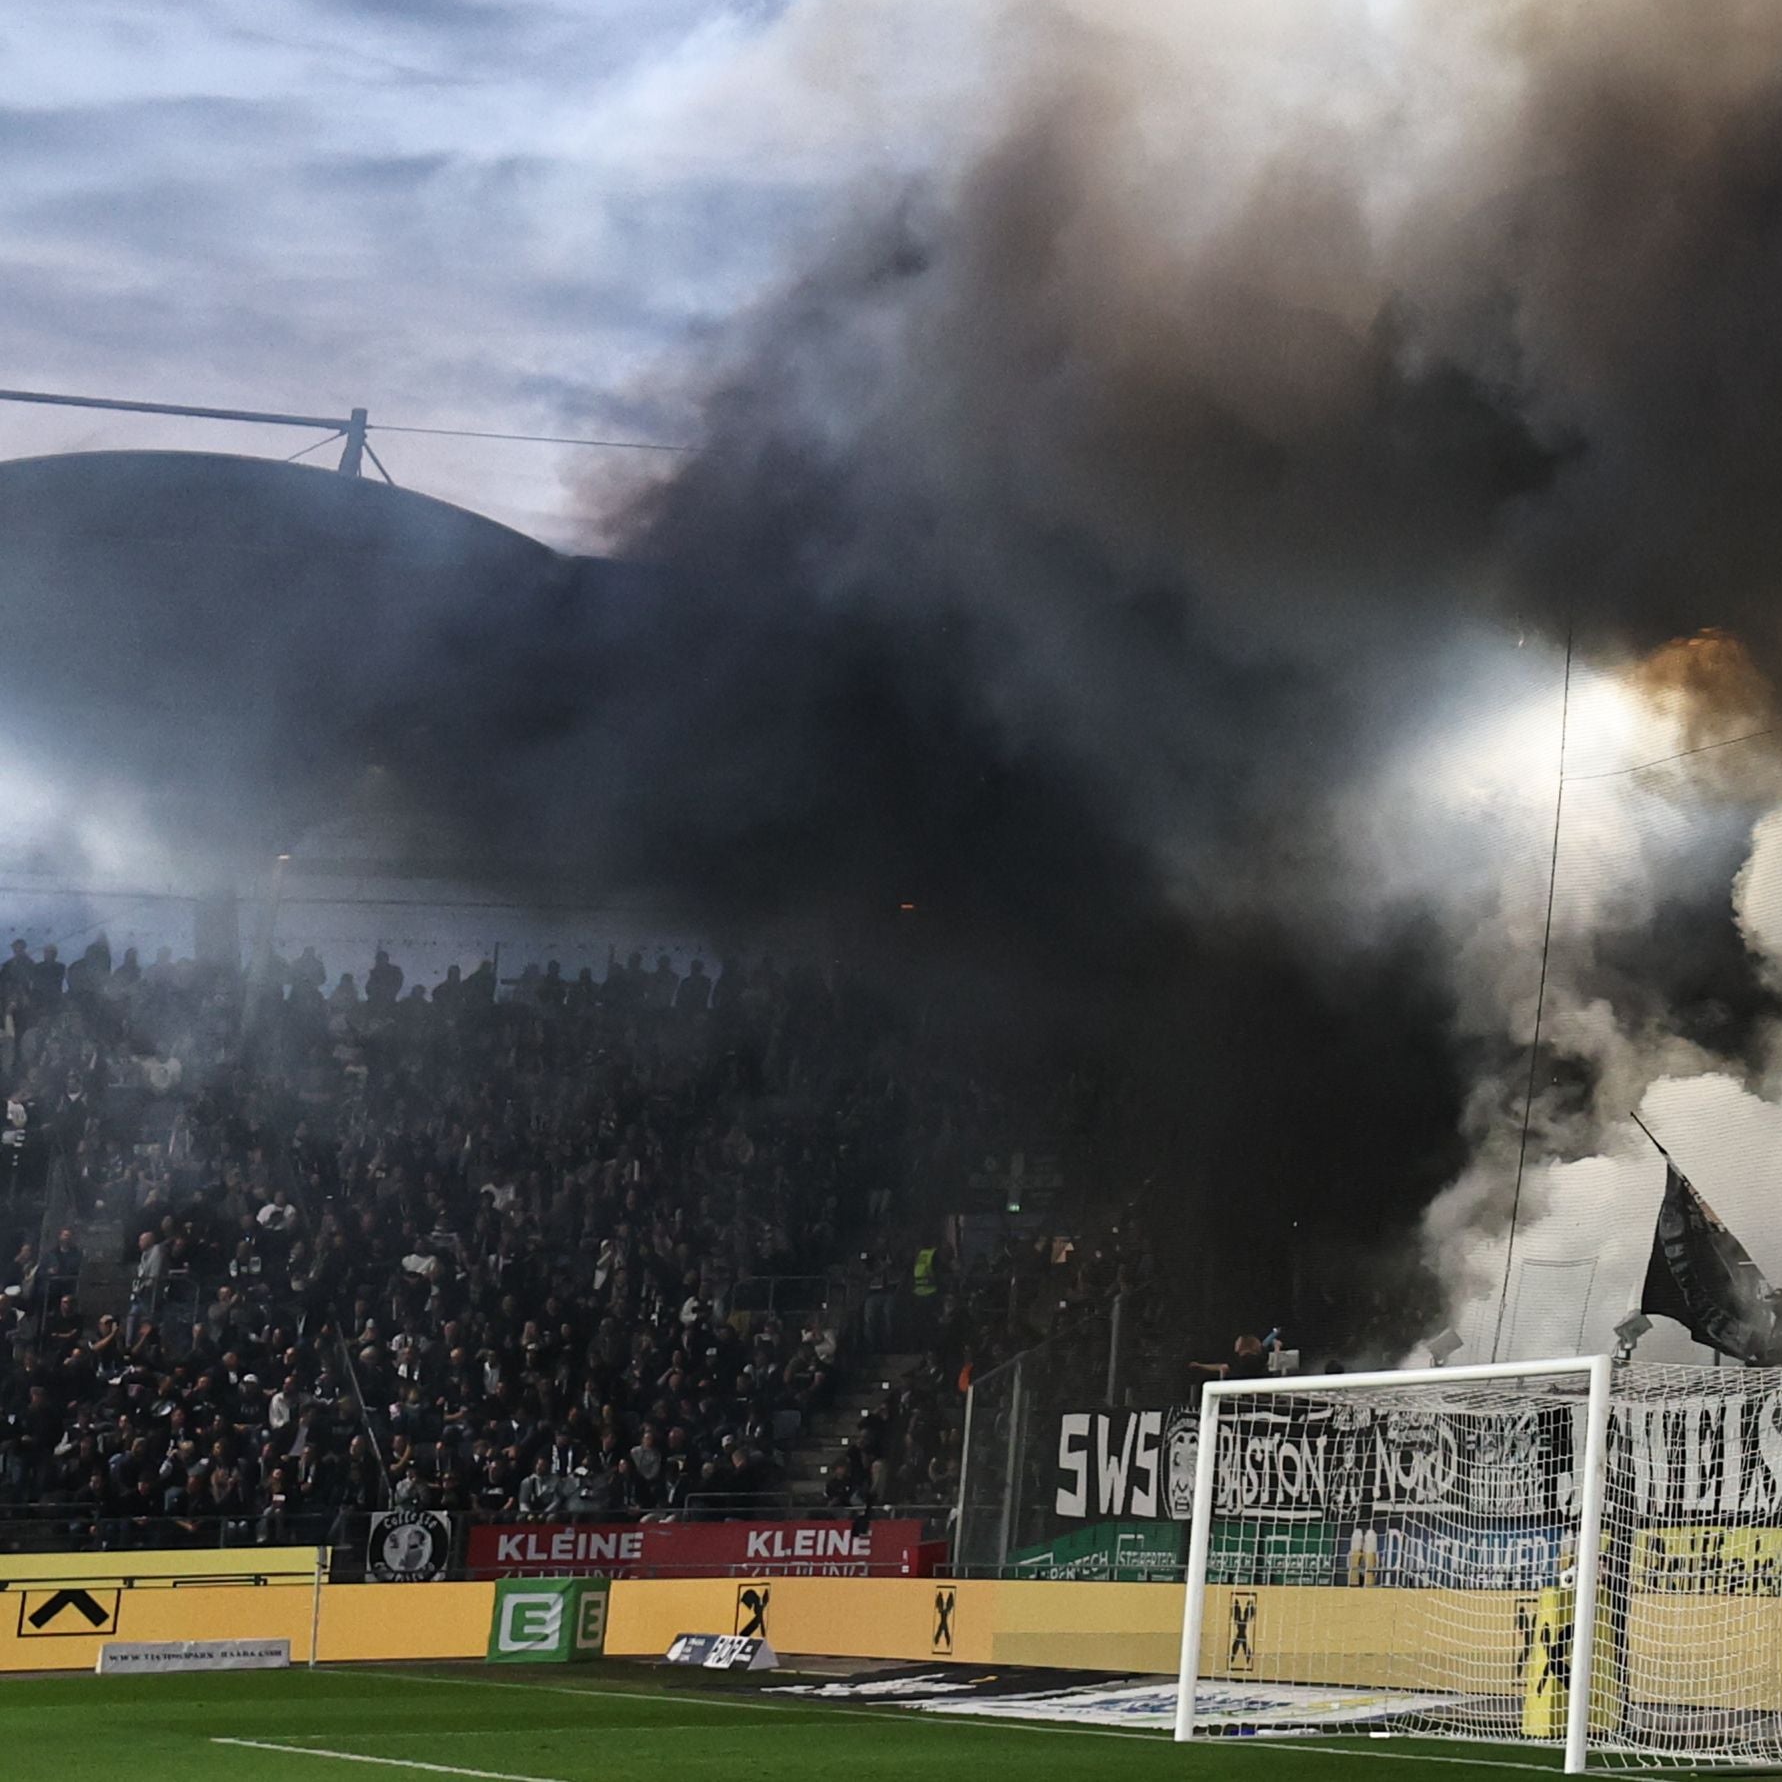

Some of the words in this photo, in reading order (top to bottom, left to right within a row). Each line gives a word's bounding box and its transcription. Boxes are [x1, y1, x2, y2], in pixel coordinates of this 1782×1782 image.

[1056, 1411, 1163, 1518] SWS
[1216, 1423, 1328, 1513] BASTION
[497, 1531, 645, 1562] KLEINE
[747, 1528, 872, 1558] KLEINE
